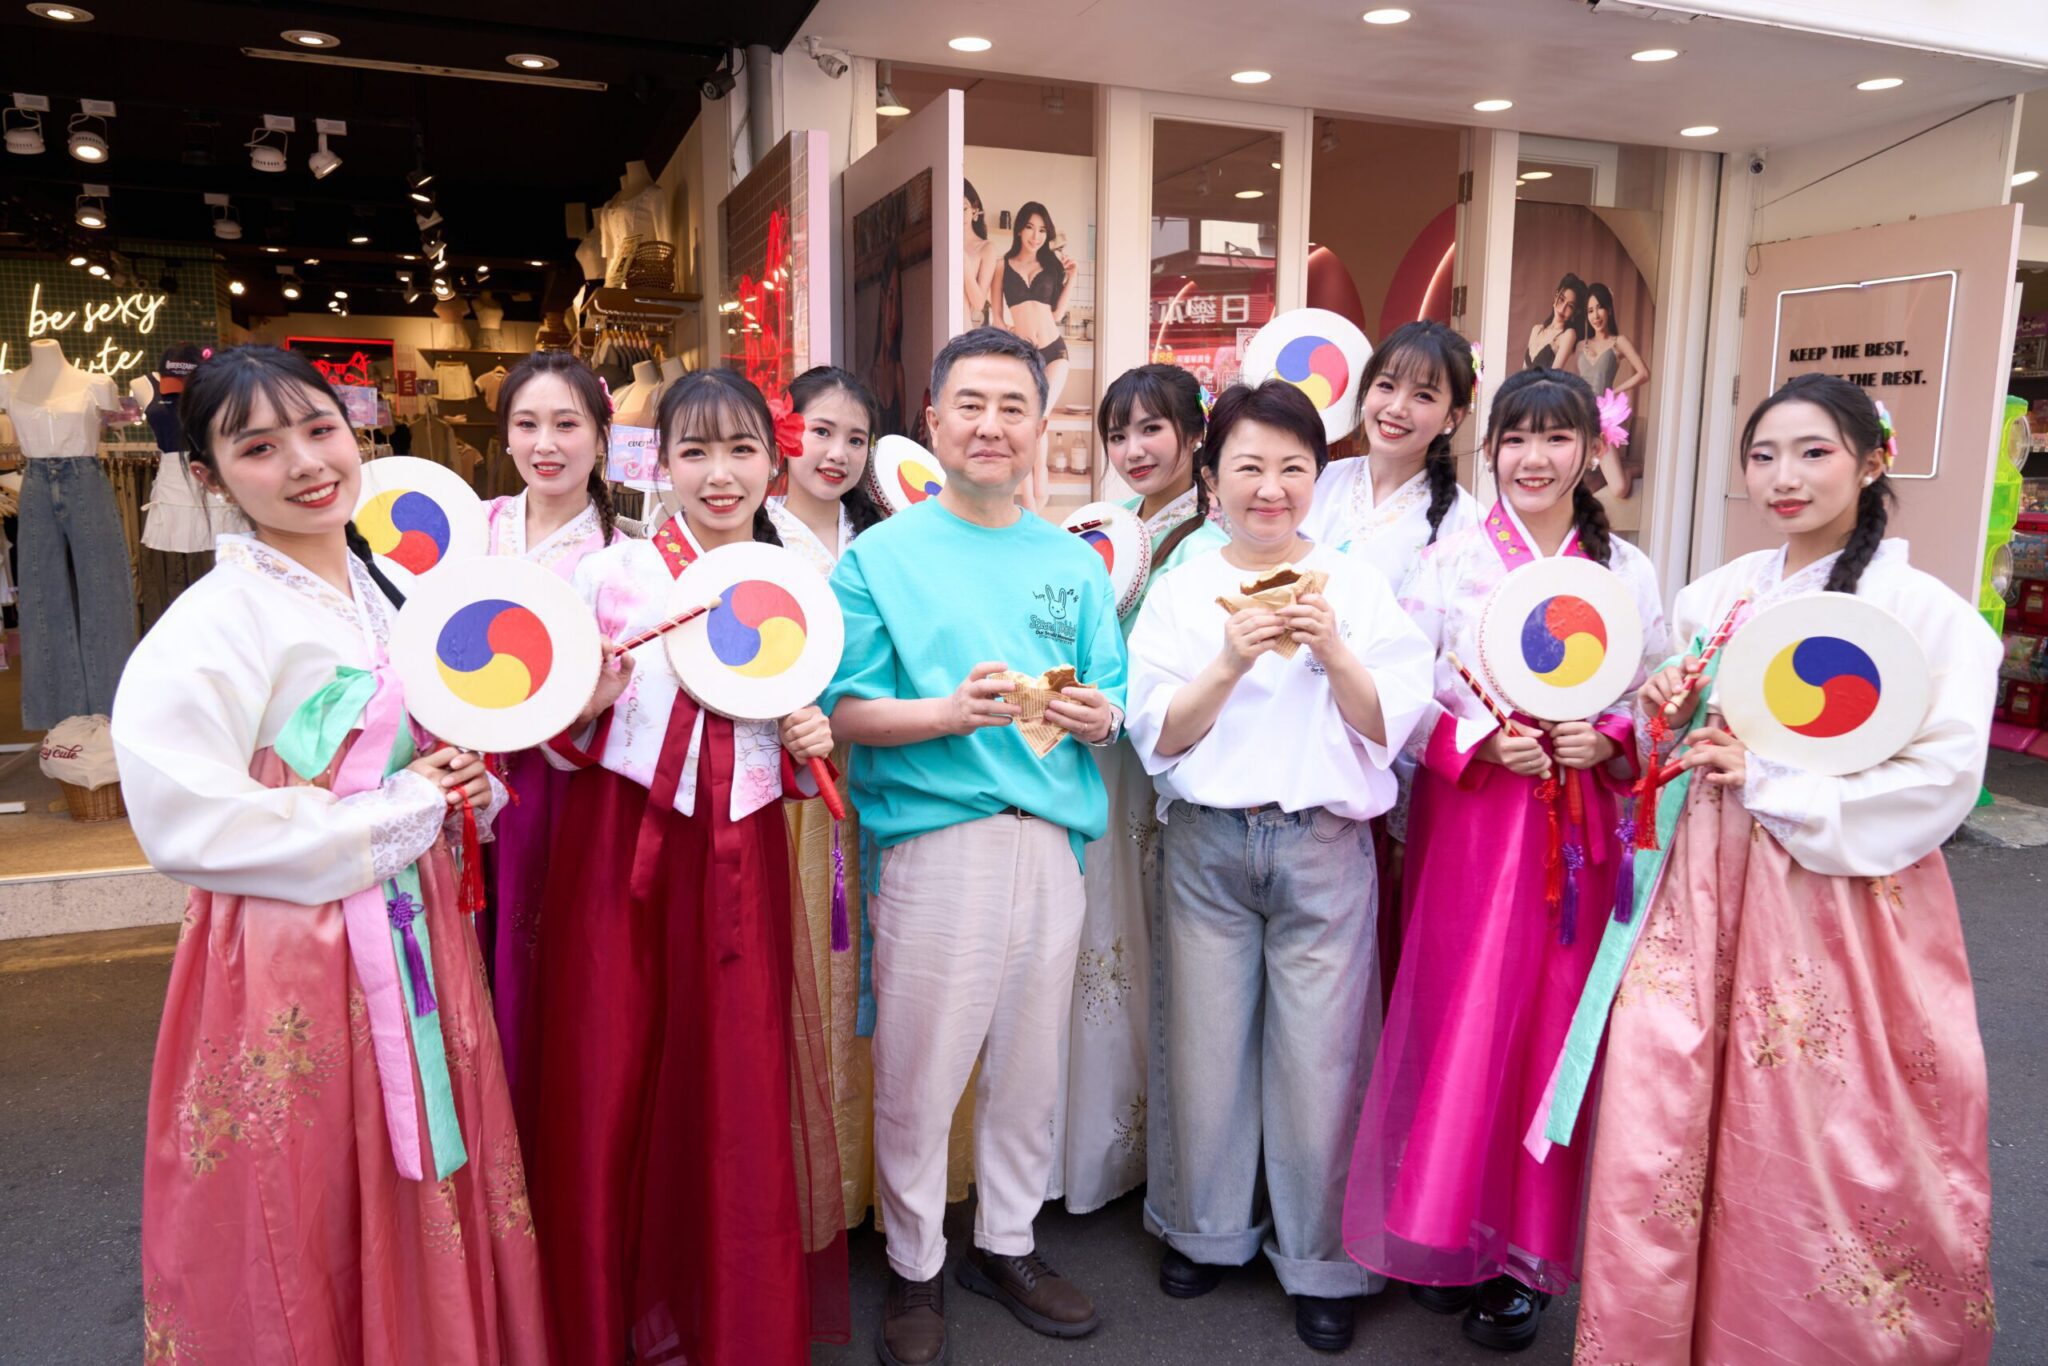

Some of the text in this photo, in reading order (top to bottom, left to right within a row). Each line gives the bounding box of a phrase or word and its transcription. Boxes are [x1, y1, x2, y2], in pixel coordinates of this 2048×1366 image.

[28, 282, 167, 338] be sexy
[1789, 340, 1909, 362] KEEP THE BEST,
[1882, 370, 1927, 386] REST.
